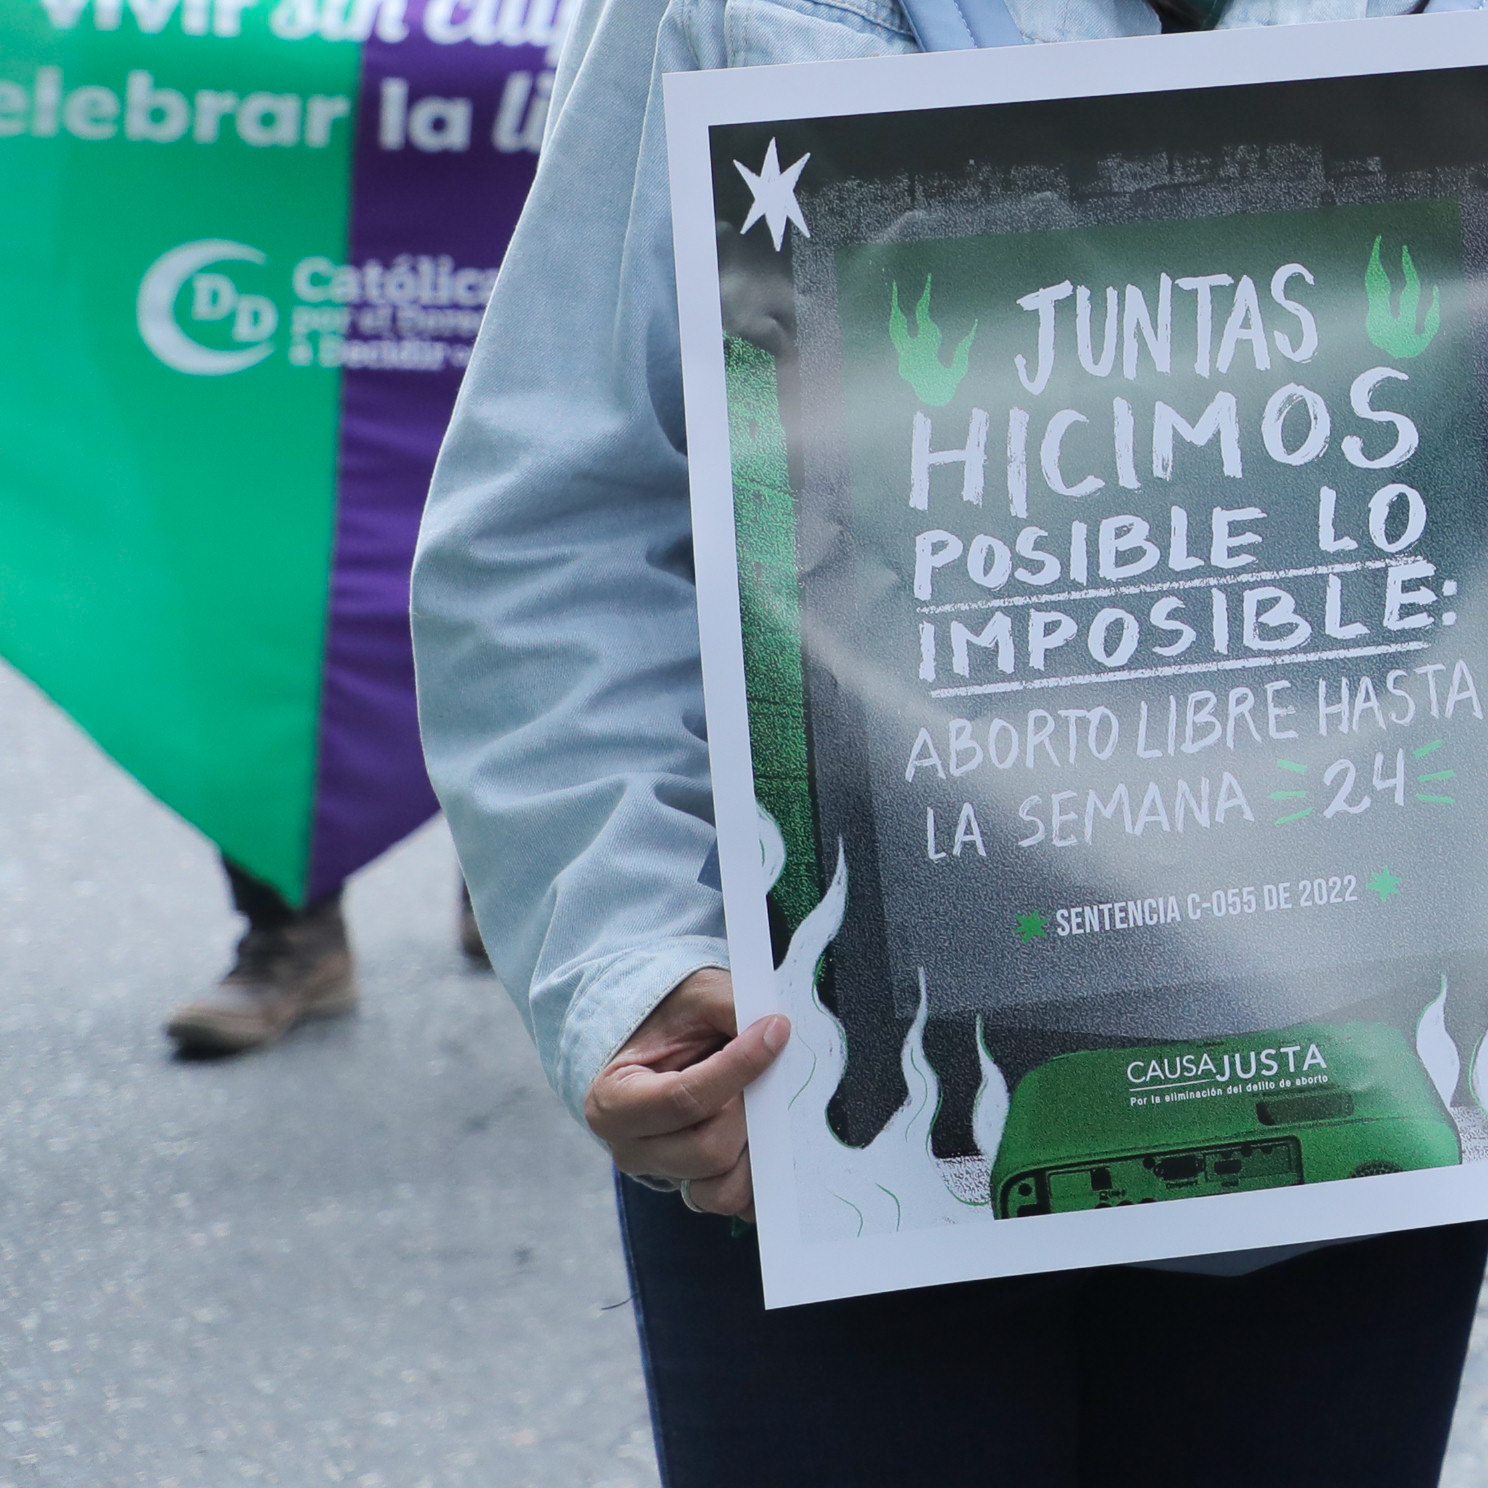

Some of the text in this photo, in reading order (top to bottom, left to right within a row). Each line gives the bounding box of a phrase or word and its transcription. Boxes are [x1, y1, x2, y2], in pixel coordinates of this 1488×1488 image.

[378, 77, 472, 153] la
[1015, 263, 1319, 395] JUNTAS
[909, 367, 1419, 517] HICIMOS
[913, 483, 1427, 600] POSIBLE LO
[918, 560, 1458, 681] IMPOSIBLE:
[905, 659, 1483, 781] ABORTO LIBRE HASTA
[926, 750, 1407, 861] LA SEMANA 24
[1055, 874, 1358, 937] SENTENCIA C-055 DE 2022
[1130, 1074, 1328, 1106] Por la eliminación del delito de aborto
